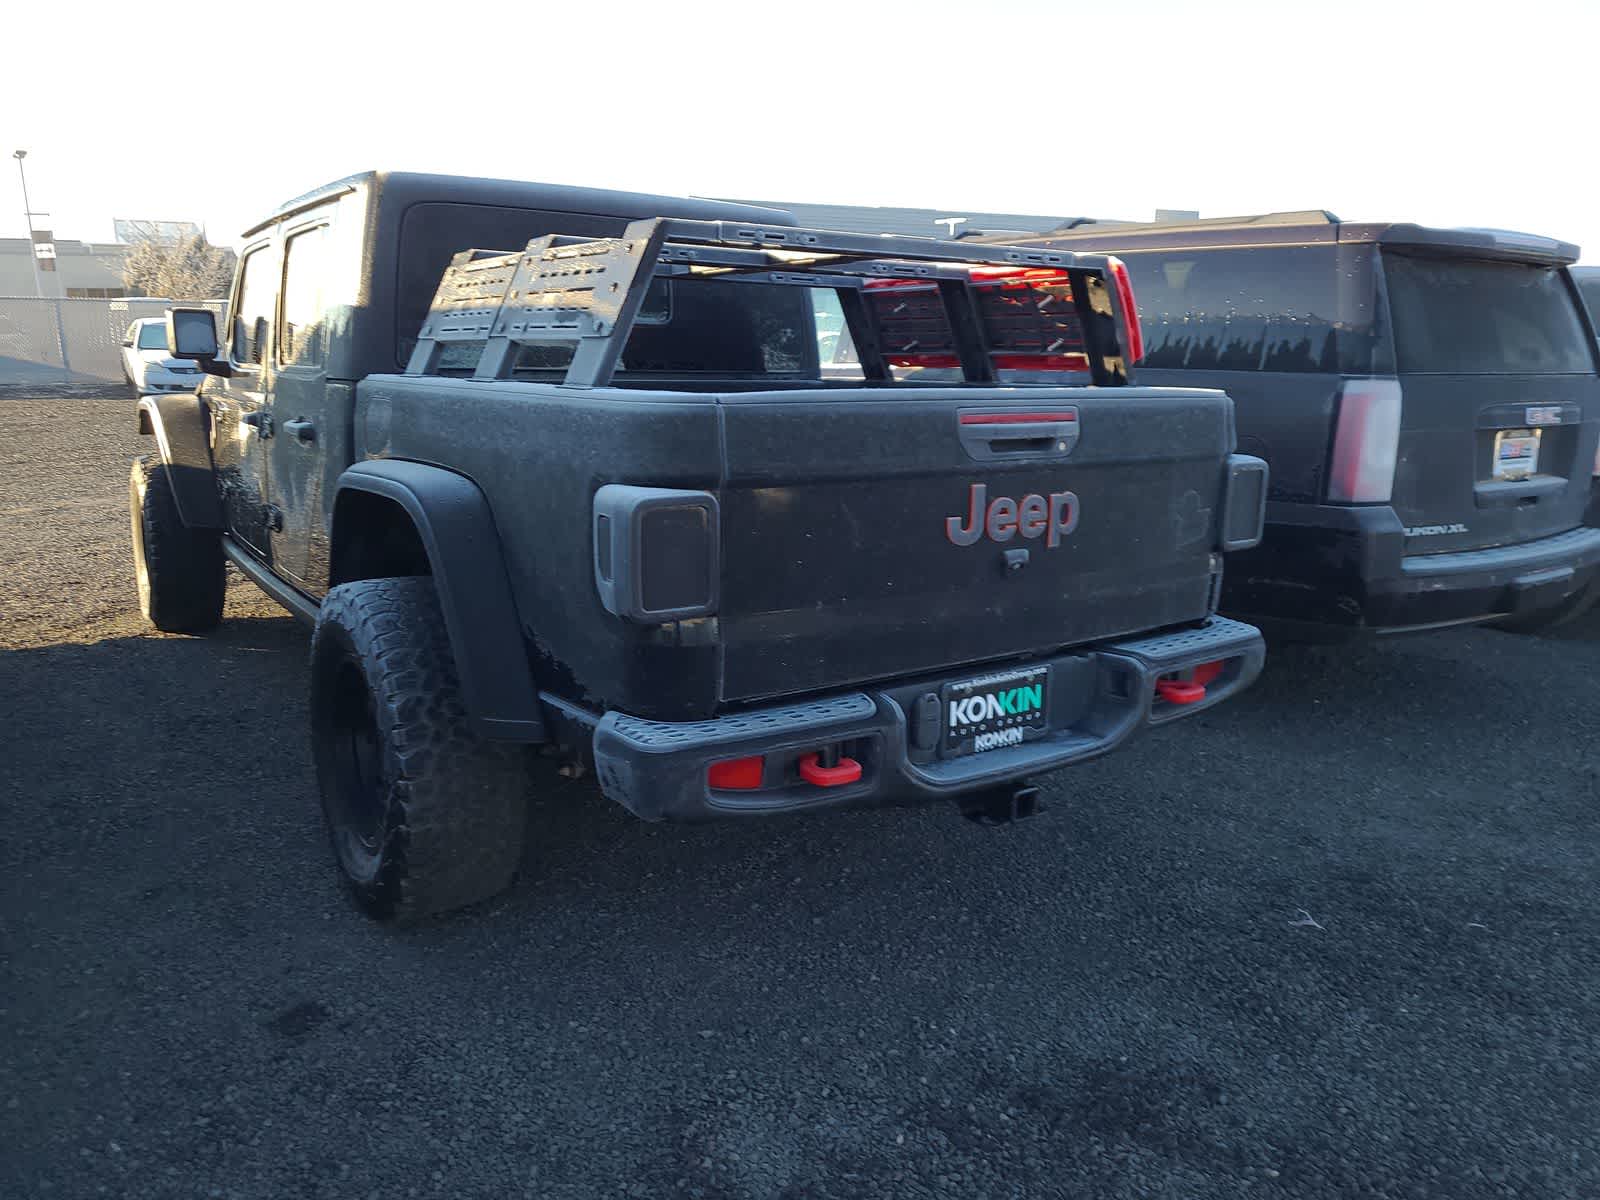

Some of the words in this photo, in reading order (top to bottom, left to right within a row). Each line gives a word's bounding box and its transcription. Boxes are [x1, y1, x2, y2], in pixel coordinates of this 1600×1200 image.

[945, 483, 1080, 548] Jeep
[949, 683, 1042, 727] KONKIN
[974, 726, 1024, 753] KONKIN
